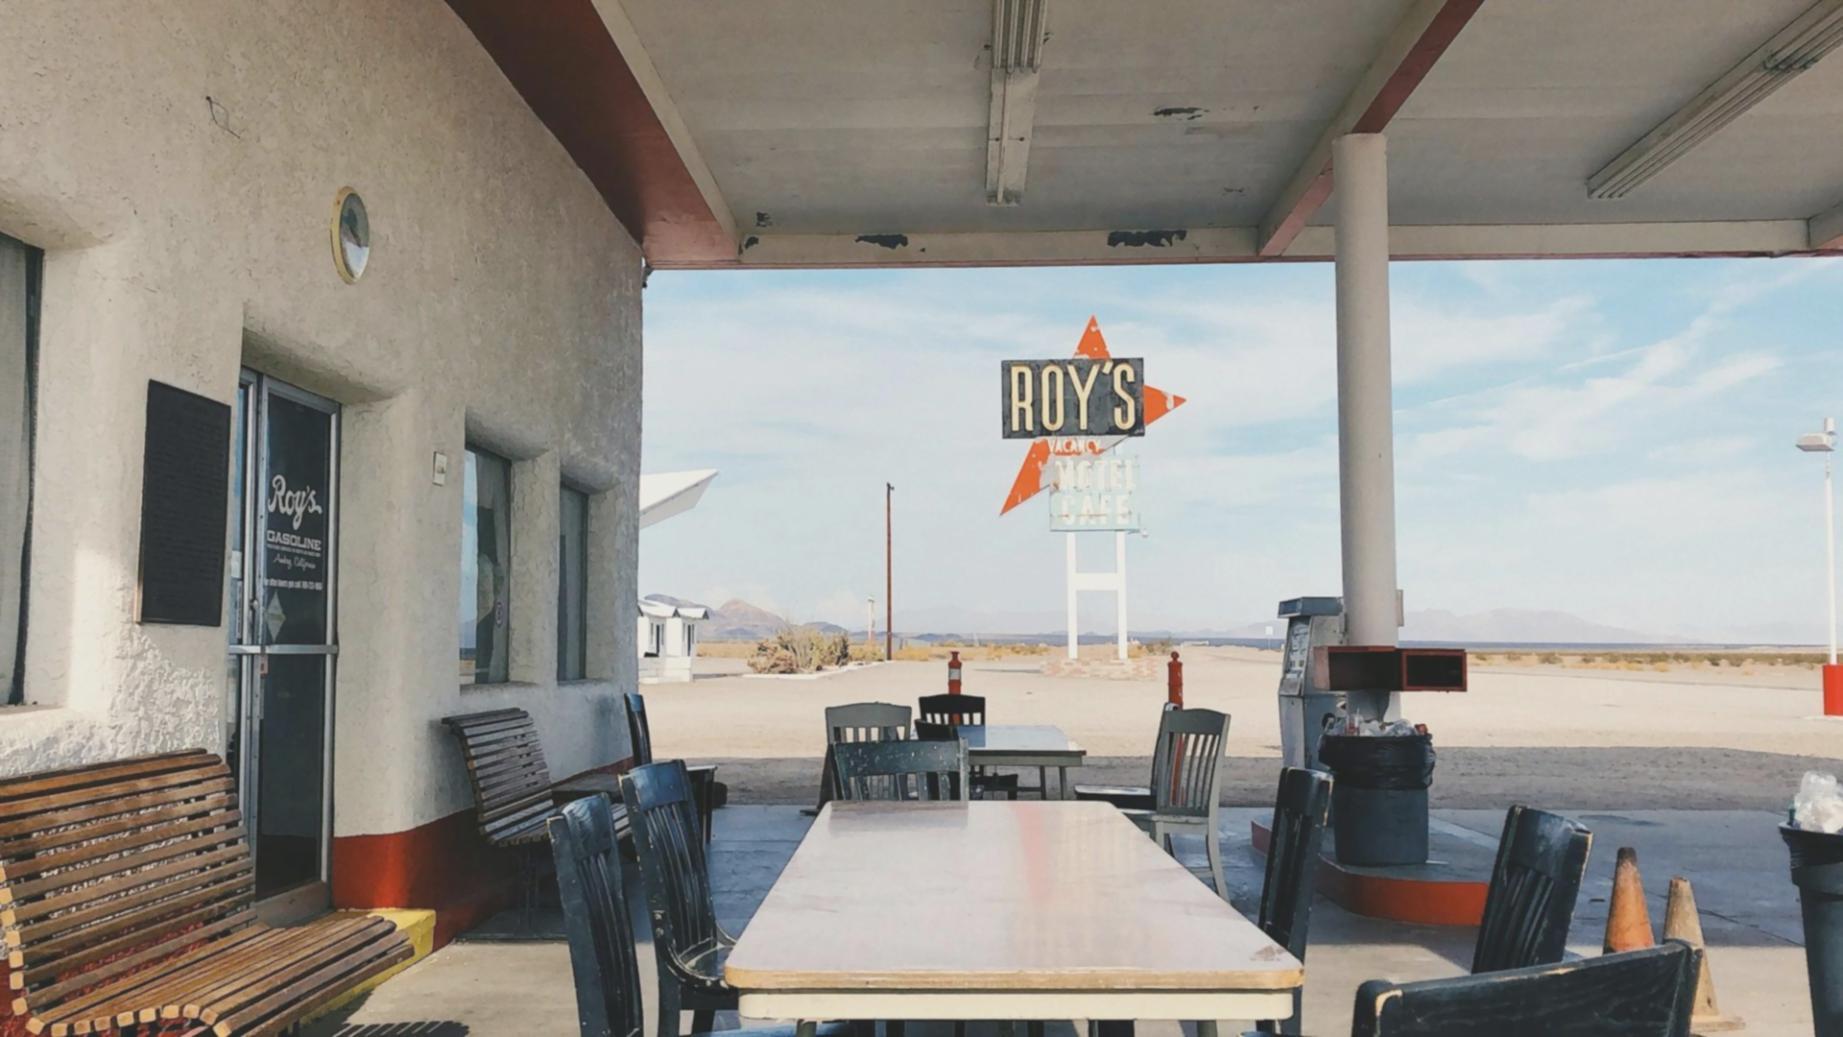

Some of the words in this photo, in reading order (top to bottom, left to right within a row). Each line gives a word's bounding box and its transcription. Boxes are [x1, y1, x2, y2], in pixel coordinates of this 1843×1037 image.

[1010, 361, 1136, 432] ROY'S
[1048, 438, 1102, 454] VACANCY
[1055, 460, 1136, 491] MOTEL
[267, 474, 323, 531] Roy's
[1061, 494, 1130, 526] CAFE
[266, 530, 322, 551] GASOLINE
